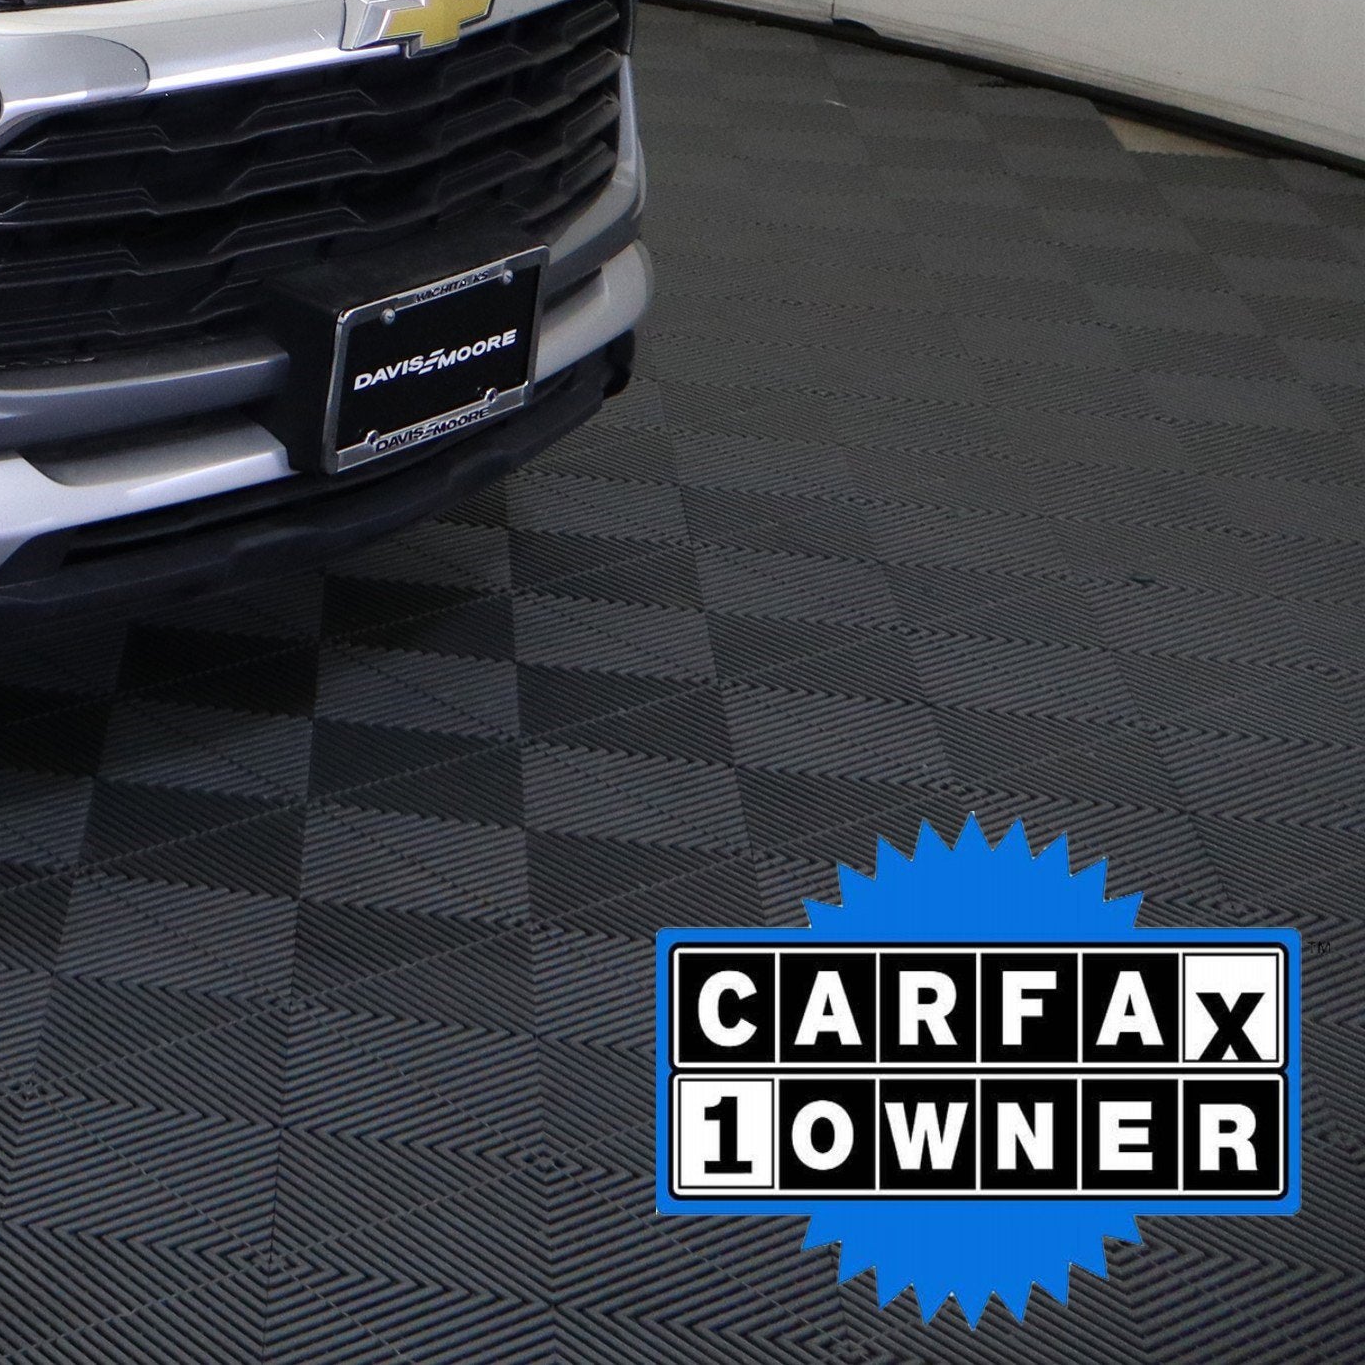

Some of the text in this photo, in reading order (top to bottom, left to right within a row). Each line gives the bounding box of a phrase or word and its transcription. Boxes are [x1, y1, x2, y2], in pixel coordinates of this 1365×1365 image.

[414, 278, 468, 303] WICHITA
[354, 328, 518, 391] DAVIS MOORE
[375, 406, 490, 453] DAVIS MOORE
